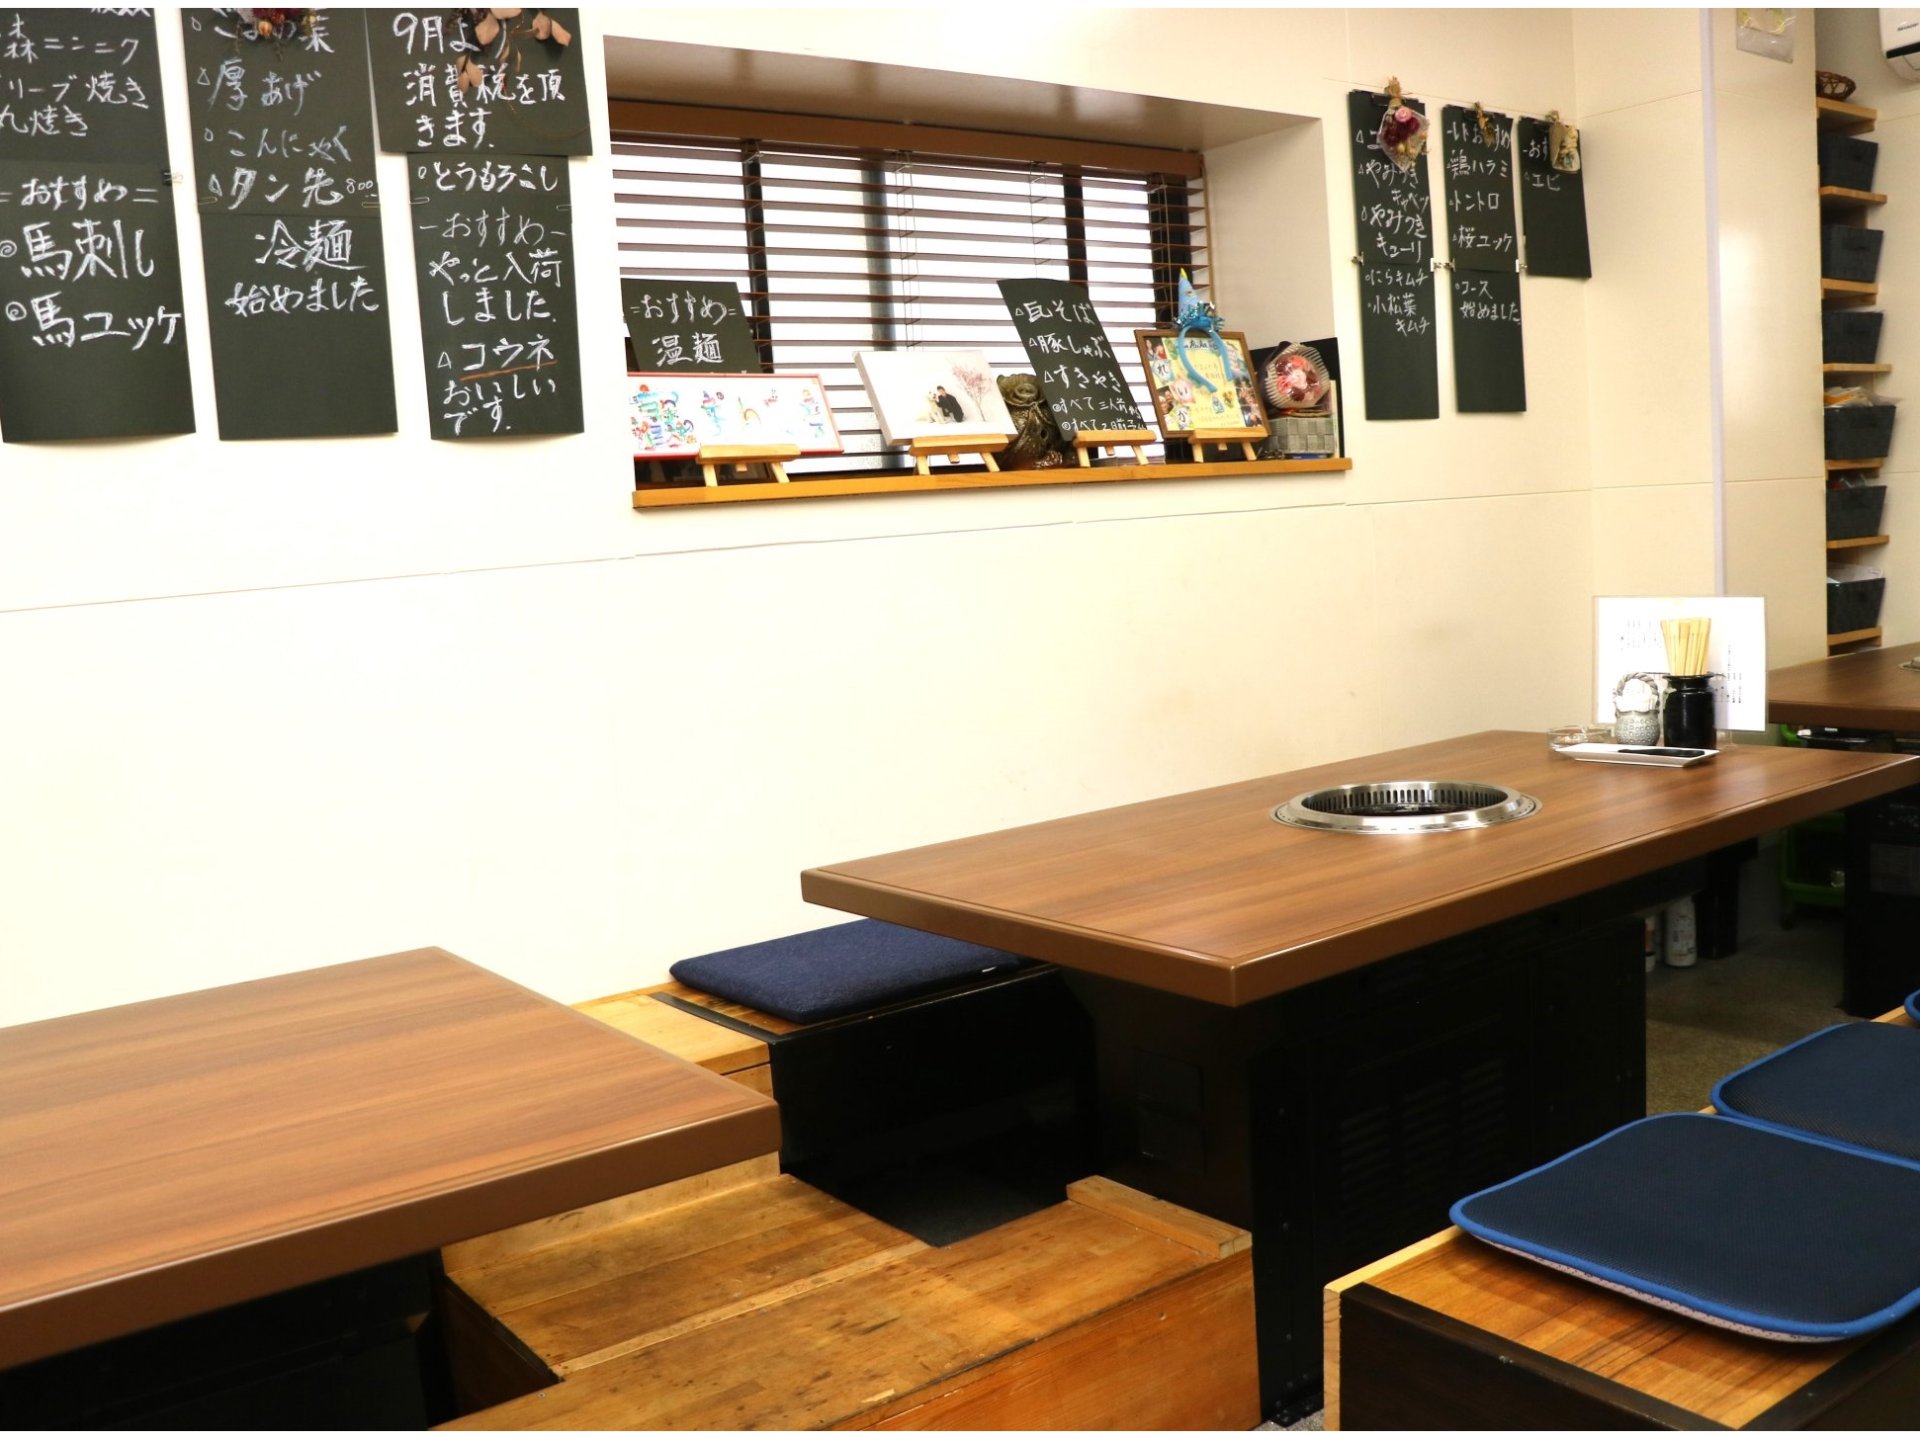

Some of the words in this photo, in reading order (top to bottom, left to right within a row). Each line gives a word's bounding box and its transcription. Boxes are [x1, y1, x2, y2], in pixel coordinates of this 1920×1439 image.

[0, 13, 140, 65] 森ニンニク
[0, 71, 149, 109] リーブ焼き
[208, 58, 323, 116] 厚あげ
[228, 126, 352, 164] こんにゃく
[228, 168, 344, 210] タン先
[433, 161, 559, 193] とうもろこし
[1532, 173, 1561, 191] エビ
[1370, 203, 1428, 239] やみつき
[22, 219, 155, 281] 馬刺し
[254, 219, 368, 272] 冷麺
[1376, 231, 1422, 263] キューリ
[428, 248, 563, 287] やっと入荷
[1370, 267, 1429, 287] にらキムチ
[225, 276, 380, 317] 始めました
[1461, 280, 1494, 300] コース
[32, 292, 182, 350] 馬ユッケ
[1395, 316, 1431, 337] キムチ
[461, 333, 555, 371] コウネ
[652, 332, 724, 367] 温麺
[1037, 333, 1112, 359] 豚しゃぶ
[443, 374, 557, 407] おいしい
[1053, 364, 1122, 393] すきやき
